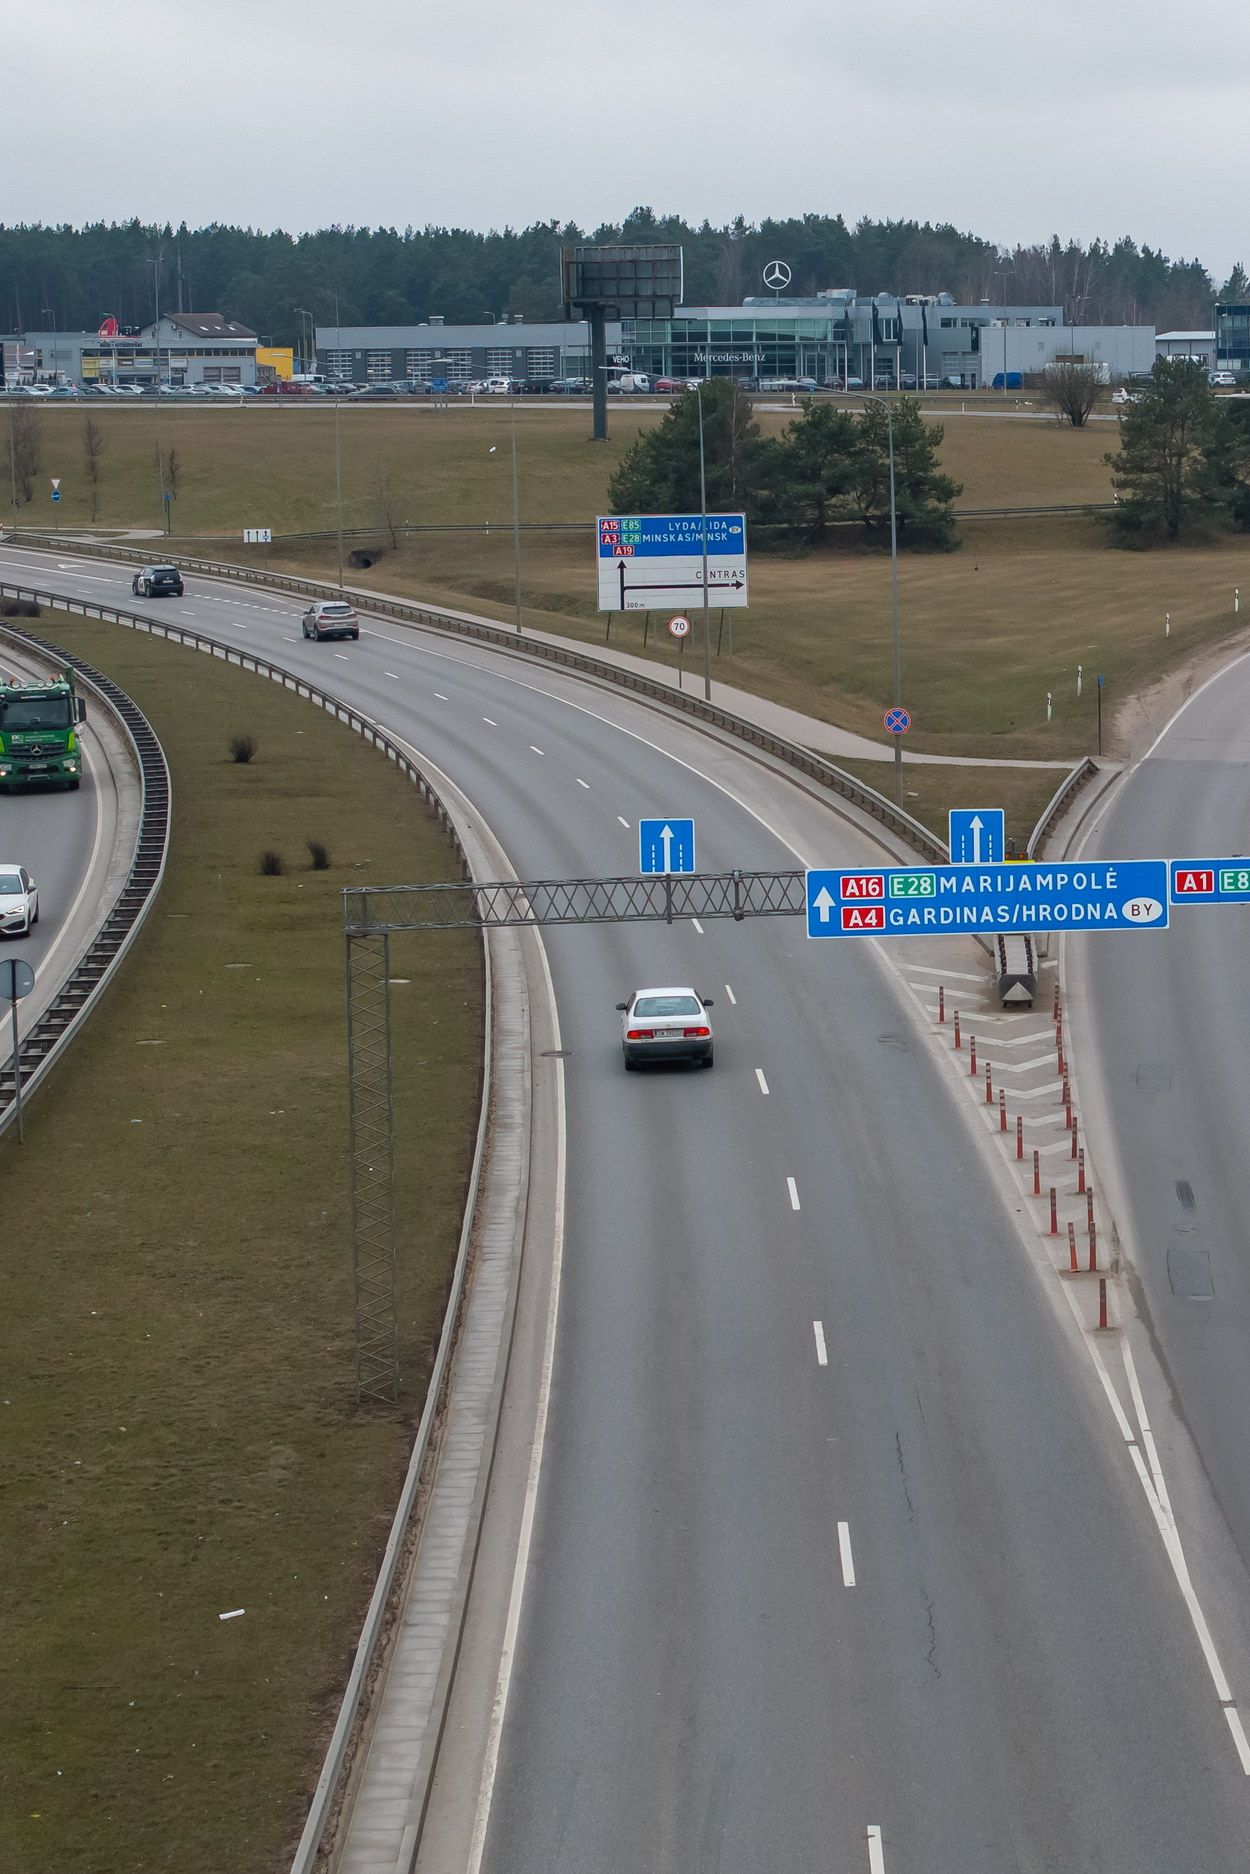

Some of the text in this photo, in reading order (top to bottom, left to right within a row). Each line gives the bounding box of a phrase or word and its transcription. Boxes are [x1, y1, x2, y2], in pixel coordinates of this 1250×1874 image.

[694, 352, 766, 362] Mercedes-Benz
[602, 521, 619, 530] A15
[622, 521, 640, 530] E85
[668, 521, 728, 531] LYDA/IDA
[604, 532, 728, 543] A3 E28 MINSKAS/MNSK
[615, 546, 633, 555] A19
[695, 570, 745, 579] CNTRAS
[674, 623, 685, 631] 70
[844, 867, 1119, 897] A16 E28 MARIJAMPOLĖ
[1183, 871, 1209, 890] A1
[848, 902, 1154, 927] A4 GARDINAS/HRODNA BY
